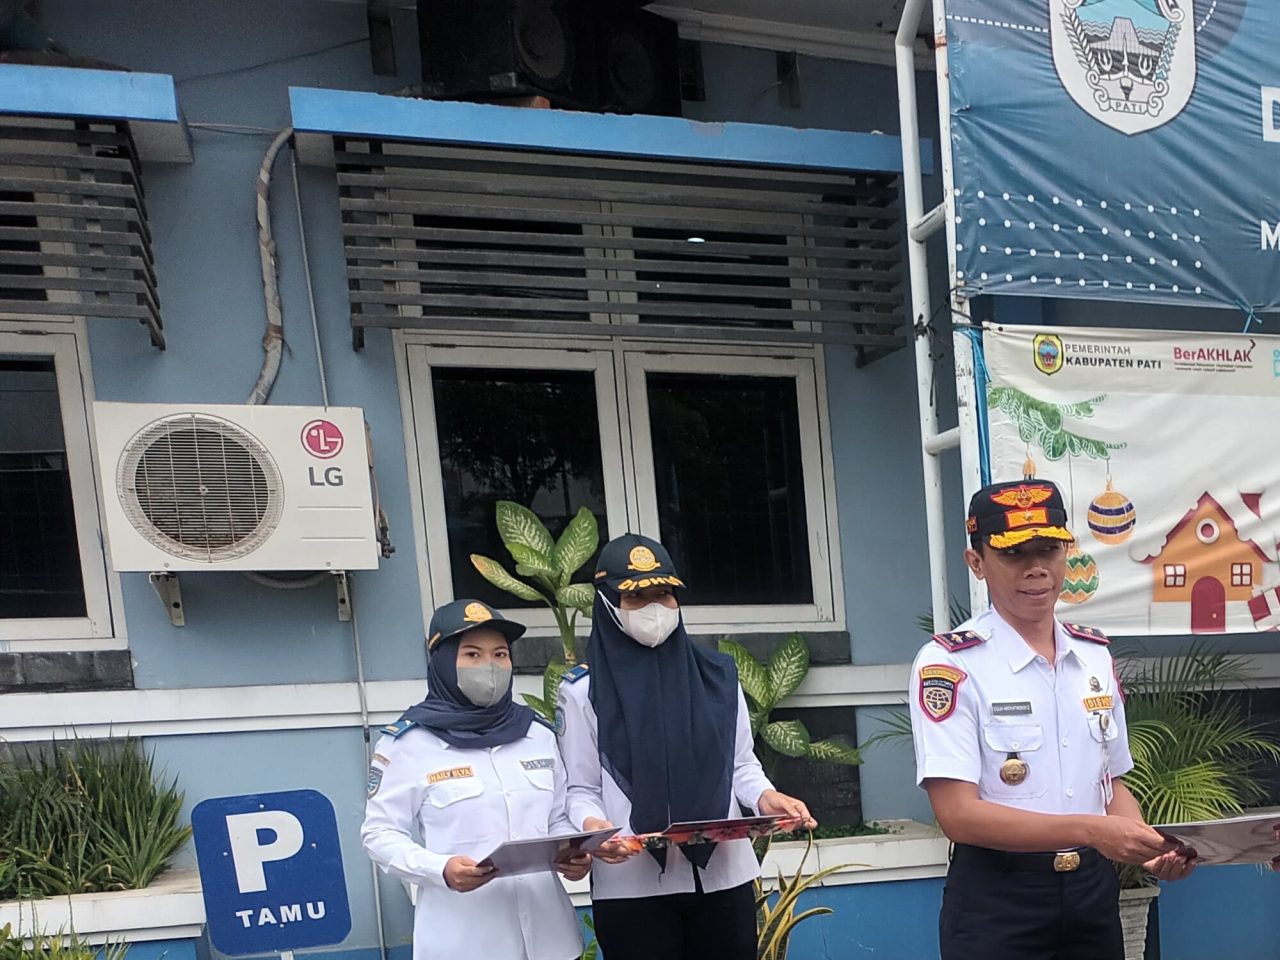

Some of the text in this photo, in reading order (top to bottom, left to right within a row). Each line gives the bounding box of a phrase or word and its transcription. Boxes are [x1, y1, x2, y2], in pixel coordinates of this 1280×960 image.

[1115, 102, 1143, 113] PATI
[1064, 343, 1131, 355] PEMERINTAH
[1173, 346, 1253, 362] BerAKHLAK
[1066, 356, 1134, 368] KABUPATEN
[1137, 359, 1162, 369] PATI
[308, 466, 344, 487] LG
[225, 810, 304, 894] P
[235, 901, 326, 928] TAMU
